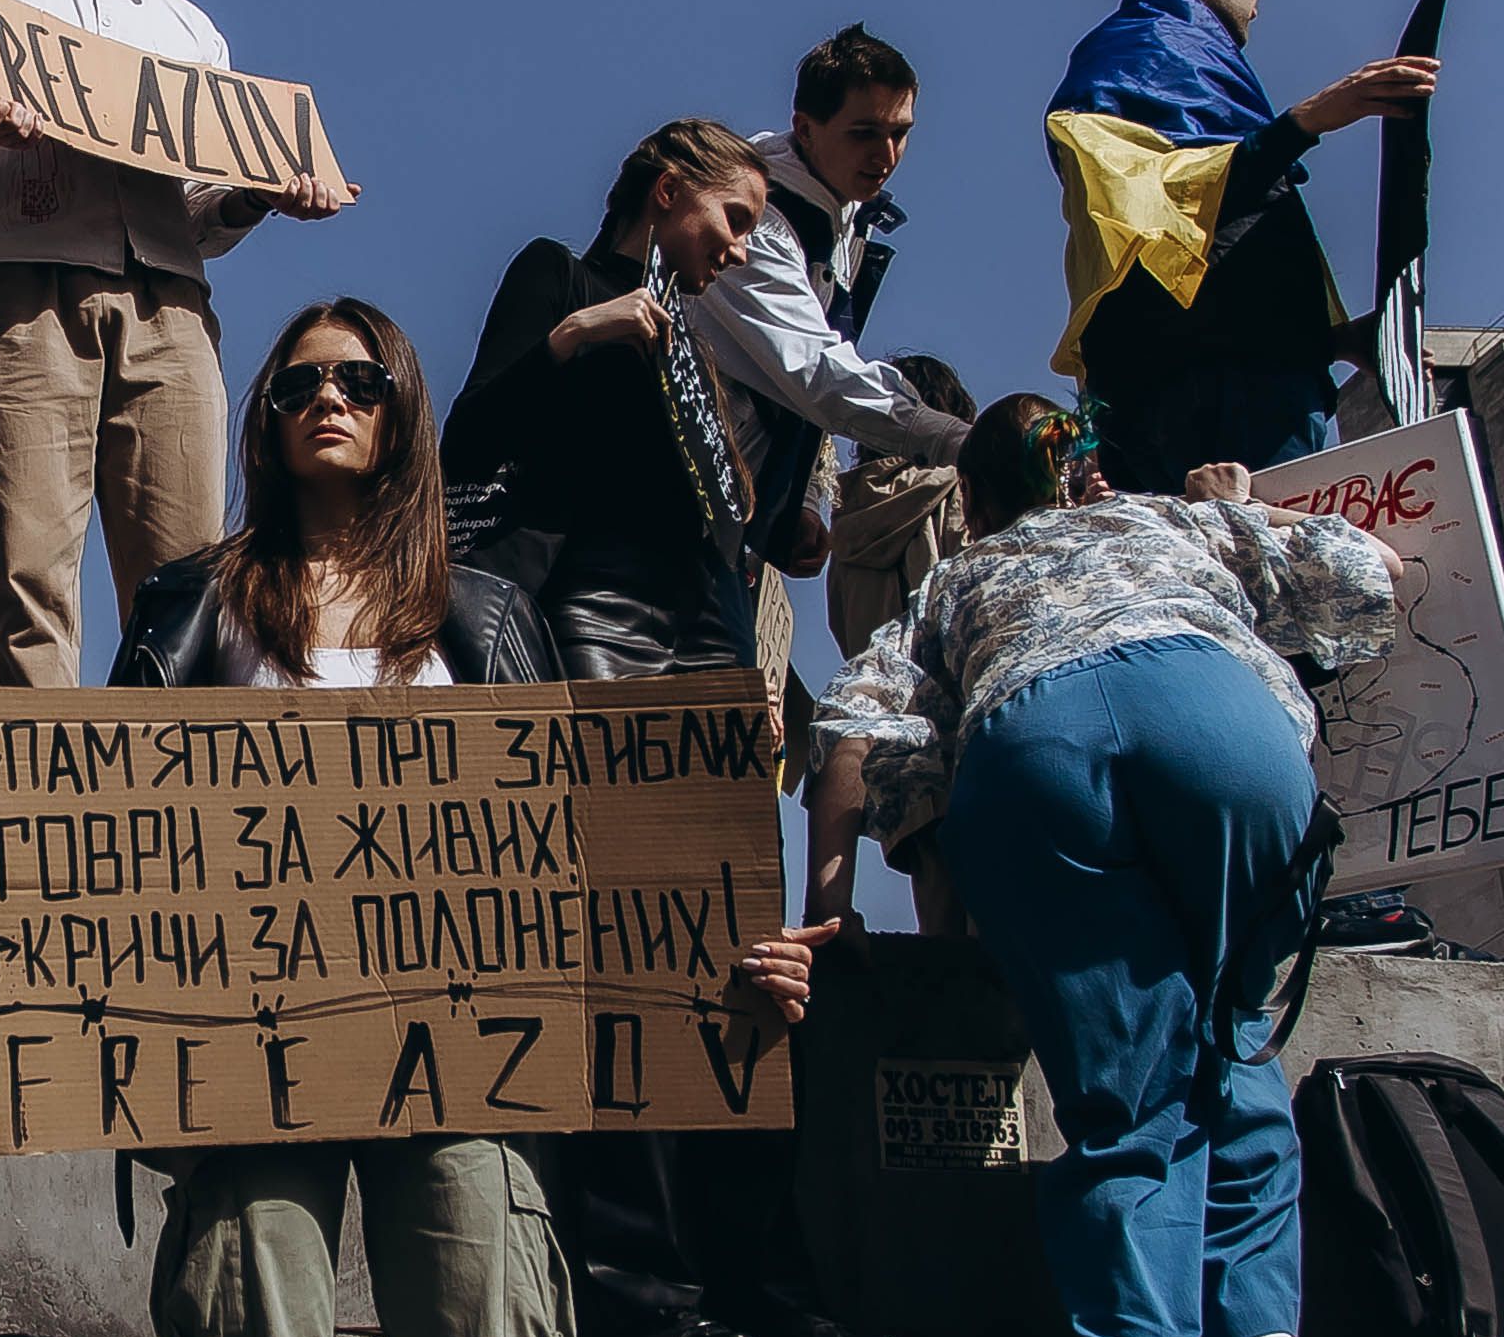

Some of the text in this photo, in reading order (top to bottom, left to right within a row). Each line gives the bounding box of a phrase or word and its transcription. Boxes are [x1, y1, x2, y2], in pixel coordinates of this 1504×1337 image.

[130, 56, 316, 185] AZOV
[1271, 458, 1436, 532] ИВАЄ
[1, 706, 770, 795] ПАМ'ЯТАЙ ПРО ЗАГИБЛИХ
[232, 804, 315, 892] ЗА
[332, 793, 580, 886] ЖИВИХ!
[21, 860, 742, 991] КРИЧИ ЗА ПОЛОНЕНИХ!
[6, 1012, 761, 1150] FREE AZOV
[881, 1071, 1017, 1109] ХОСТЕЛ
[885, 1117, 924, 1142] 093
